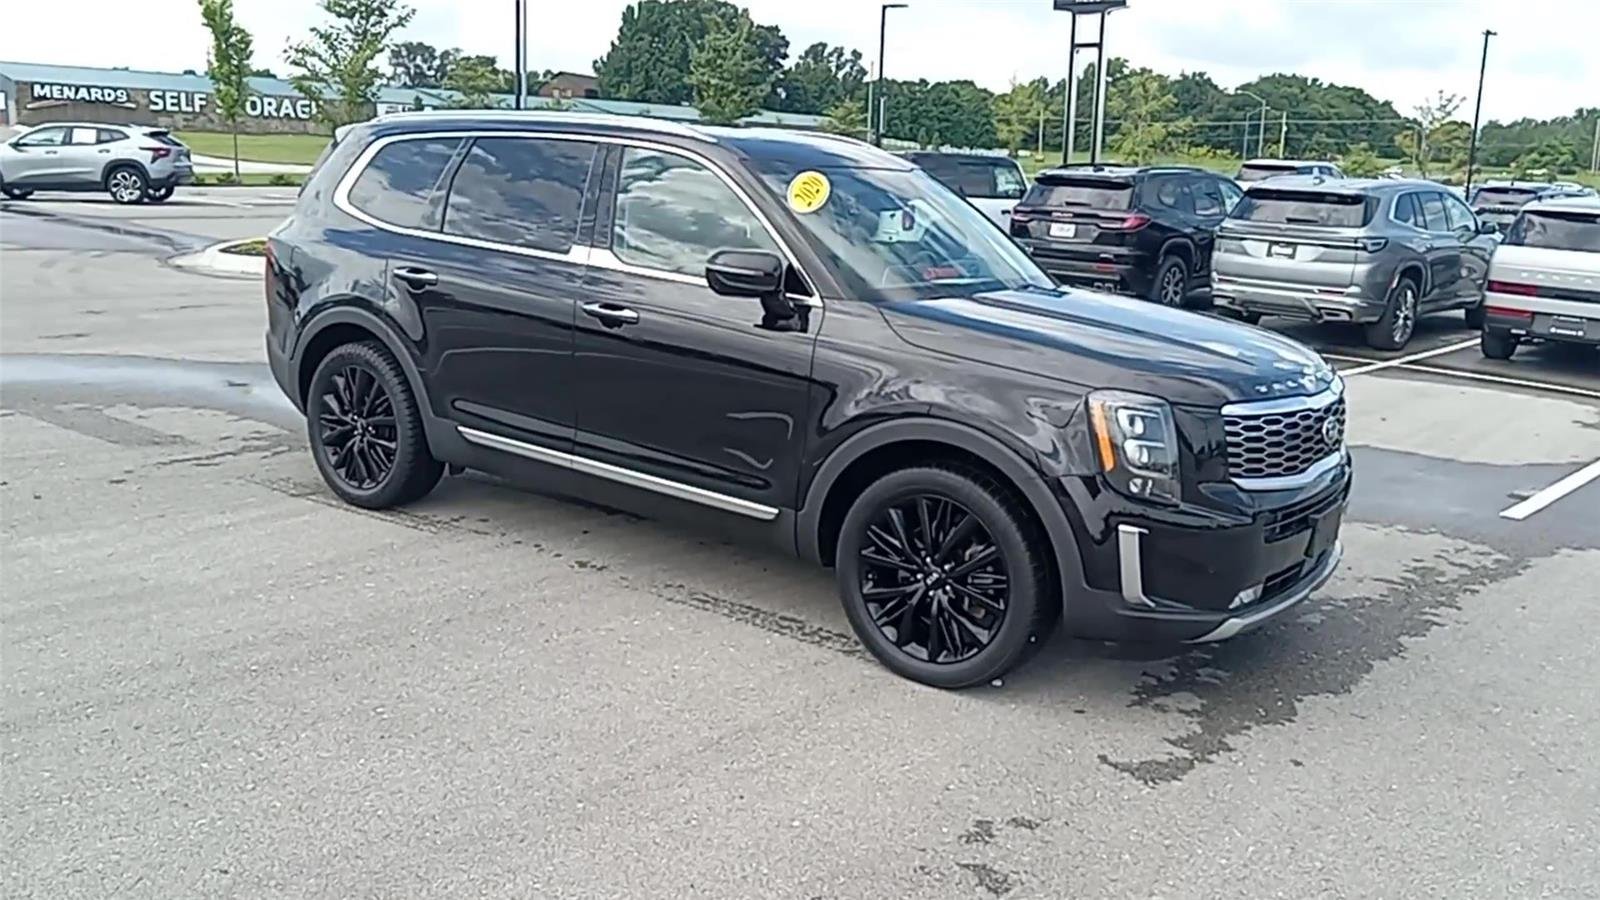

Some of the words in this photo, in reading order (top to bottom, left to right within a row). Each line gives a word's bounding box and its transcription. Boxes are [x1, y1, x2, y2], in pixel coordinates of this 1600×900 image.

[33, 83, 128, 102] MENARDS
[149, 90, 207, 113] SELF
[215, 95, 318, 119] ORAG
